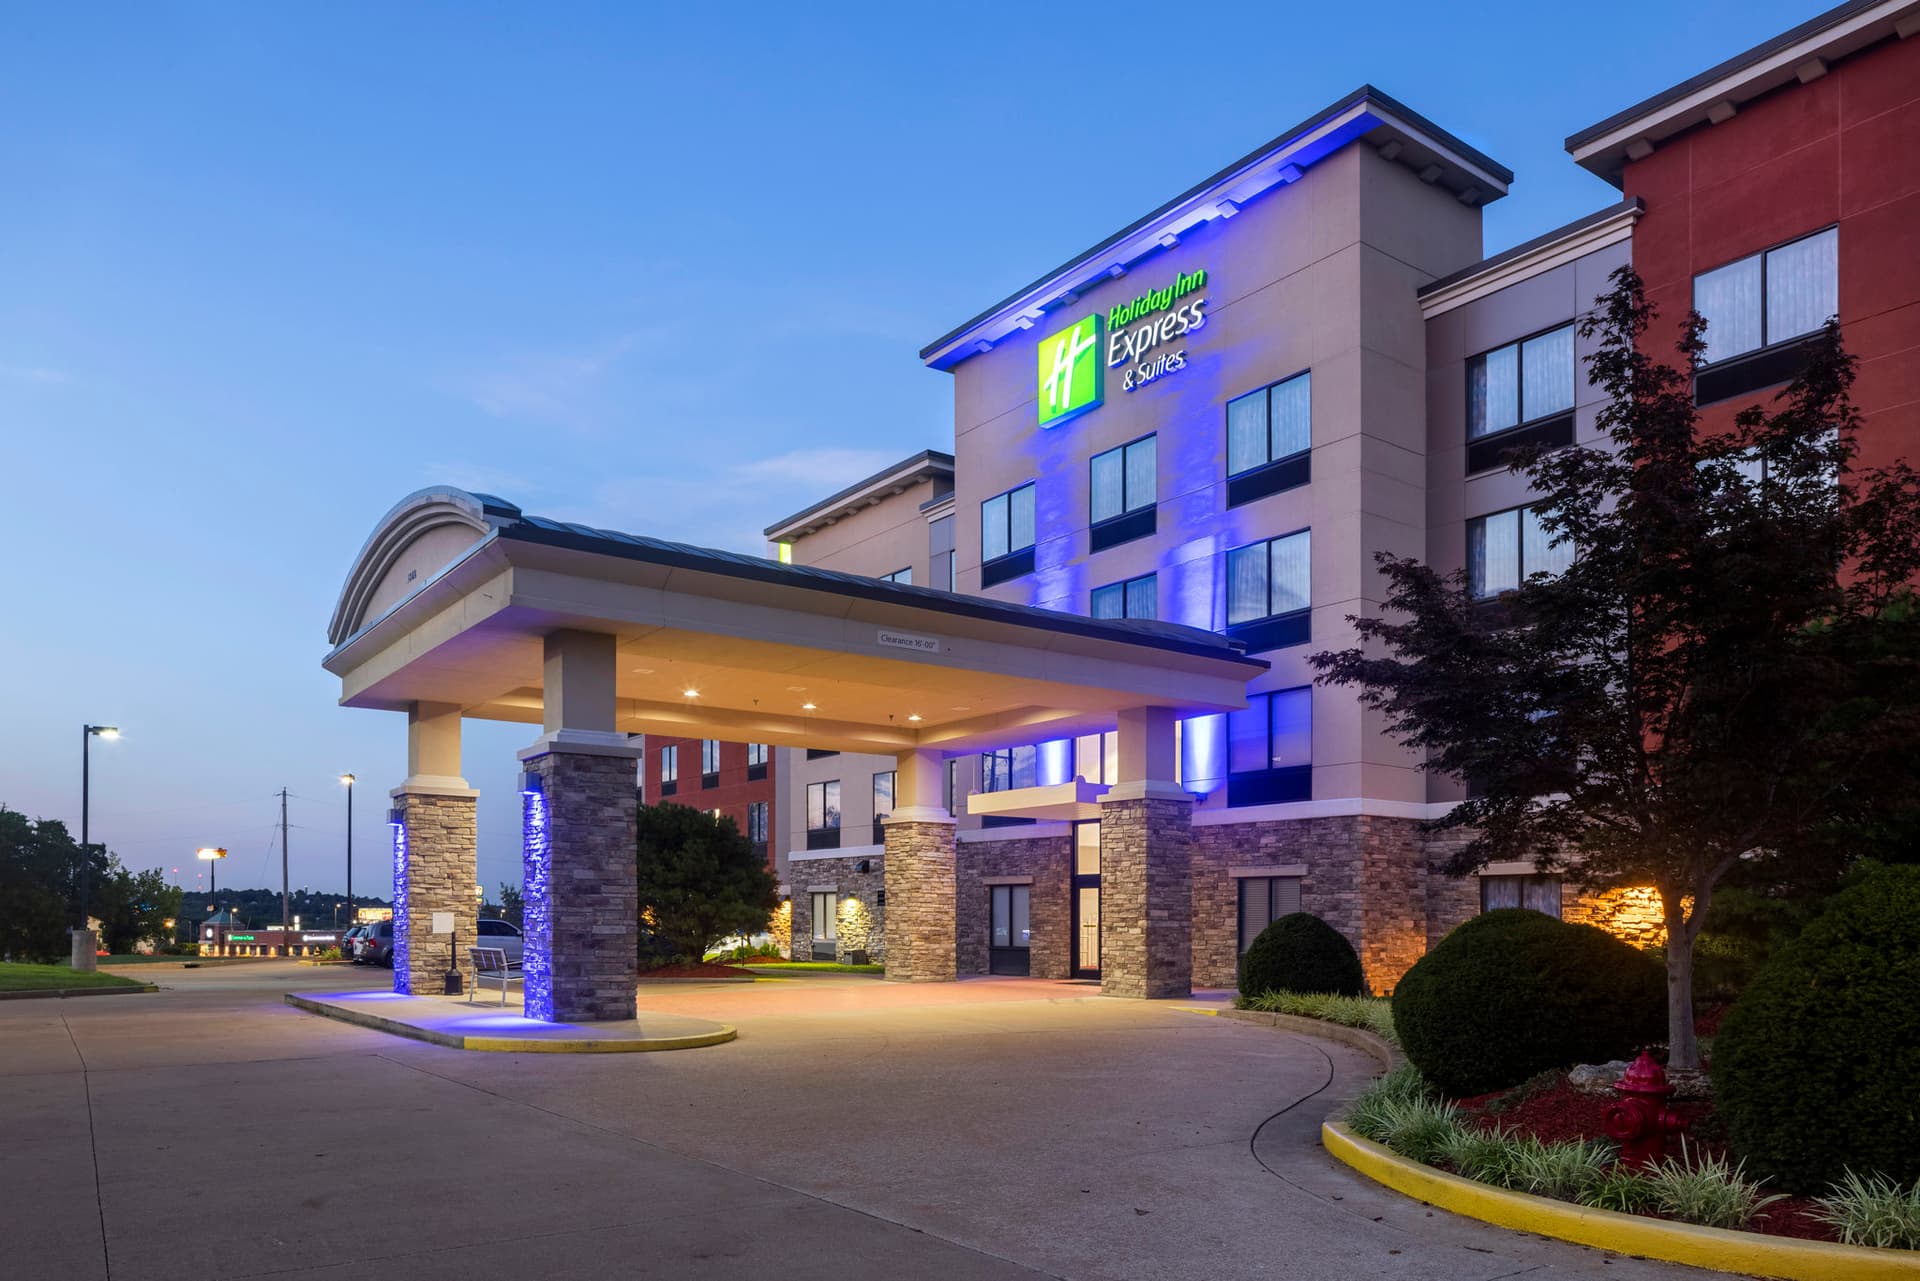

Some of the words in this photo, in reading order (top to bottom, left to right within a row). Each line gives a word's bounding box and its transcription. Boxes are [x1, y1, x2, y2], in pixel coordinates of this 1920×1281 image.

[1107, 284, 1174, 331] Holiday
[1175, 269, 1204, 298] Inn
[1108, 299, 1204, 366] Express
[1122, 369, 1135, 391] &
[1137, 350, 1184, 385] Suites
